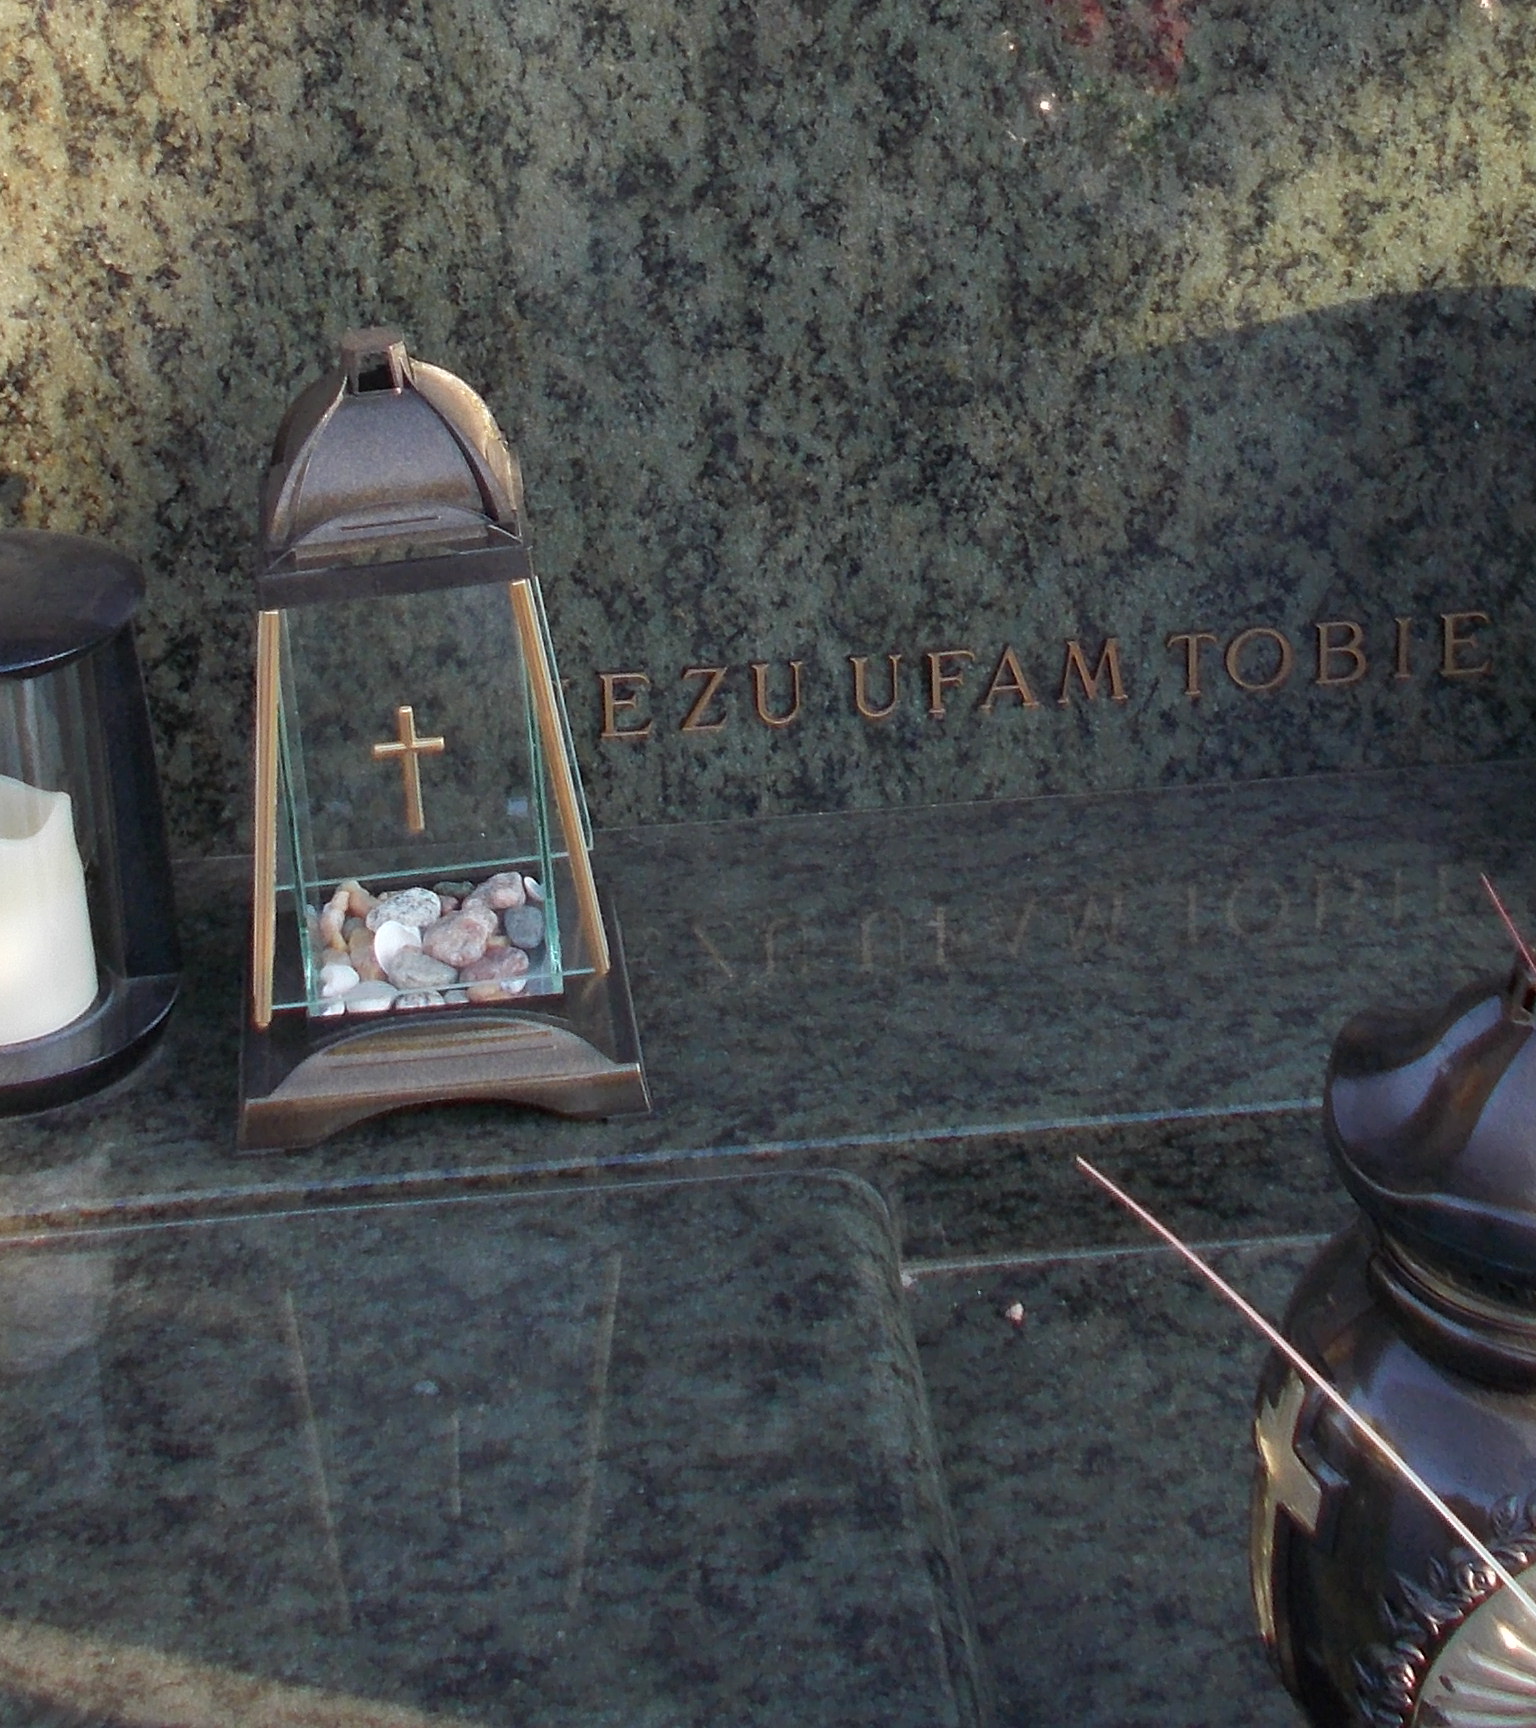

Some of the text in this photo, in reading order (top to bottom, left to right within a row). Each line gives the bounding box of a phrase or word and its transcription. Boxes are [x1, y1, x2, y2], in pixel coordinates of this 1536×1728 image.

[554, 610, 1492, 740] EZU UFAM TOBIE
